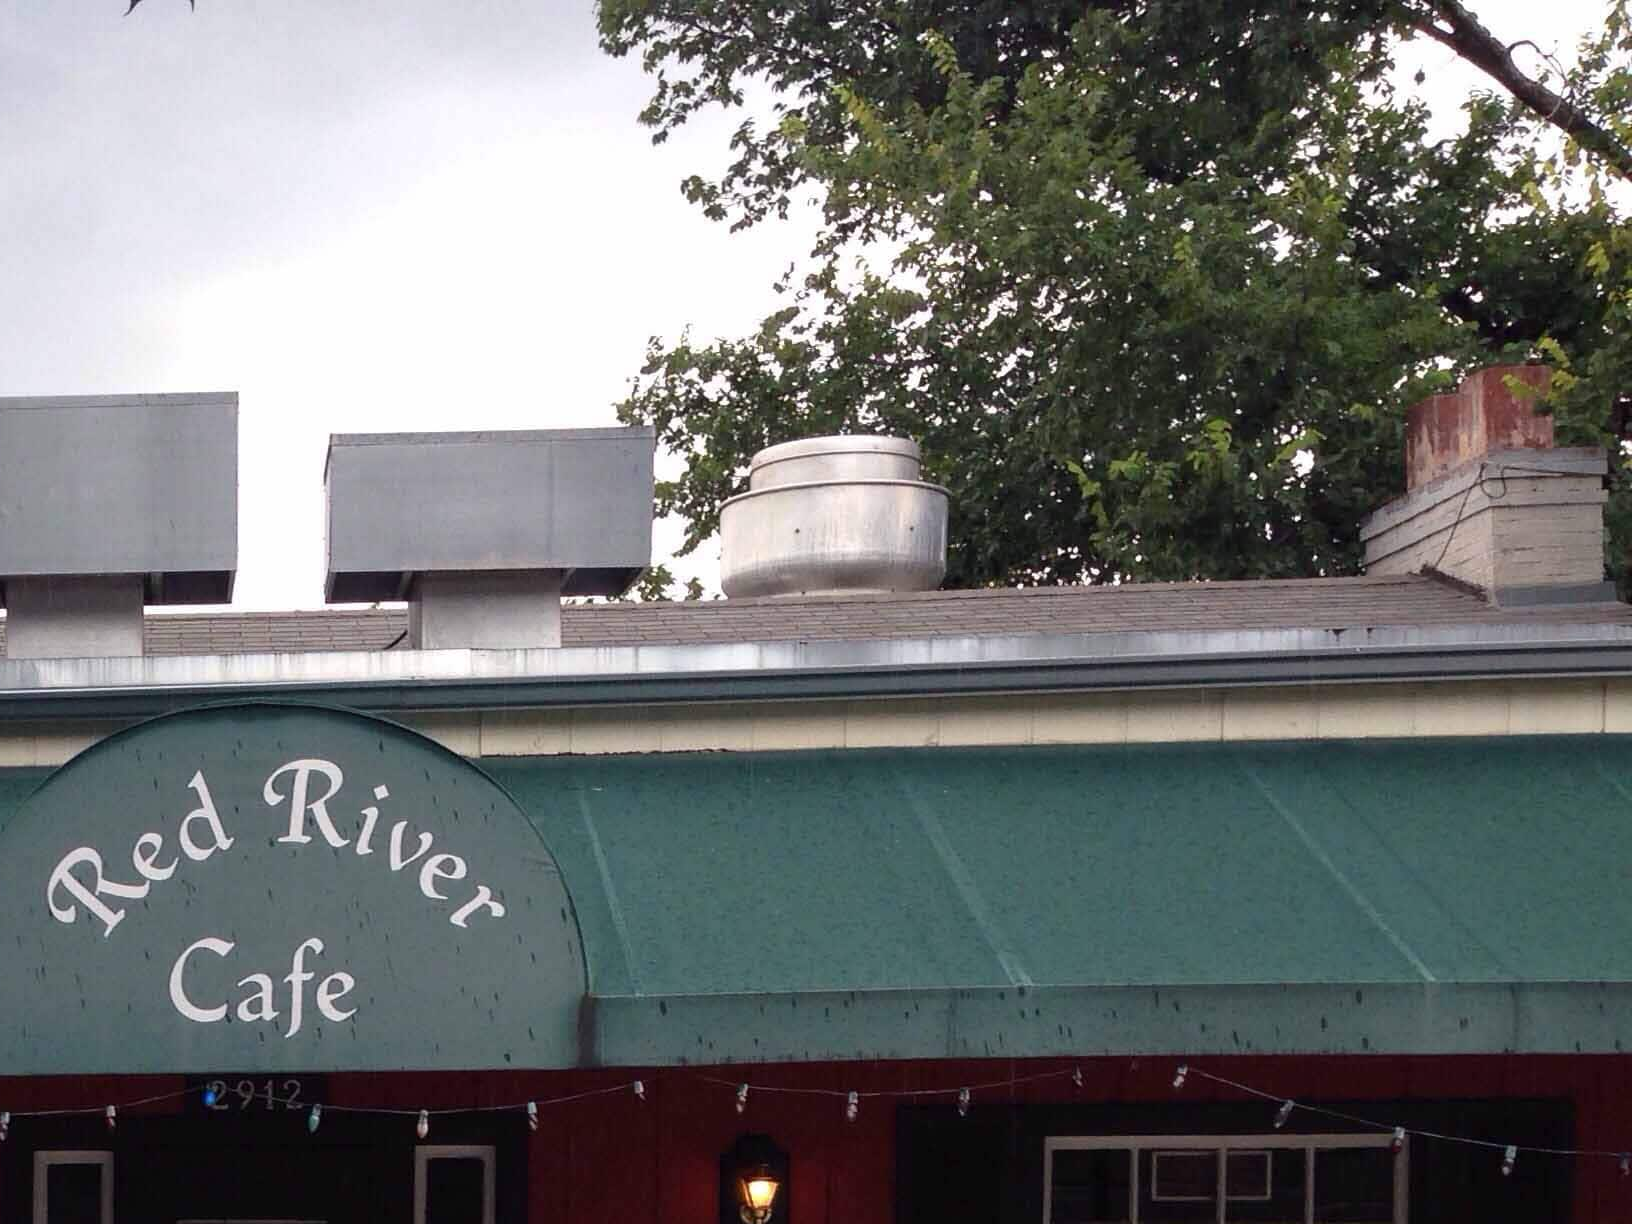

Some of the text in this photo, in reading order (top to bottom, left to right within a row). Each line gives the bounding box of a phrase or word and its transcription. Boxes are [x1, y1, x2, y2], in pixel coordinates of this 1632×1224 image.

[47, 758, 506, 937] Red River
[169, 936, 357, 1038] Cafe
[204, 1079, 305, 1111] 2912
